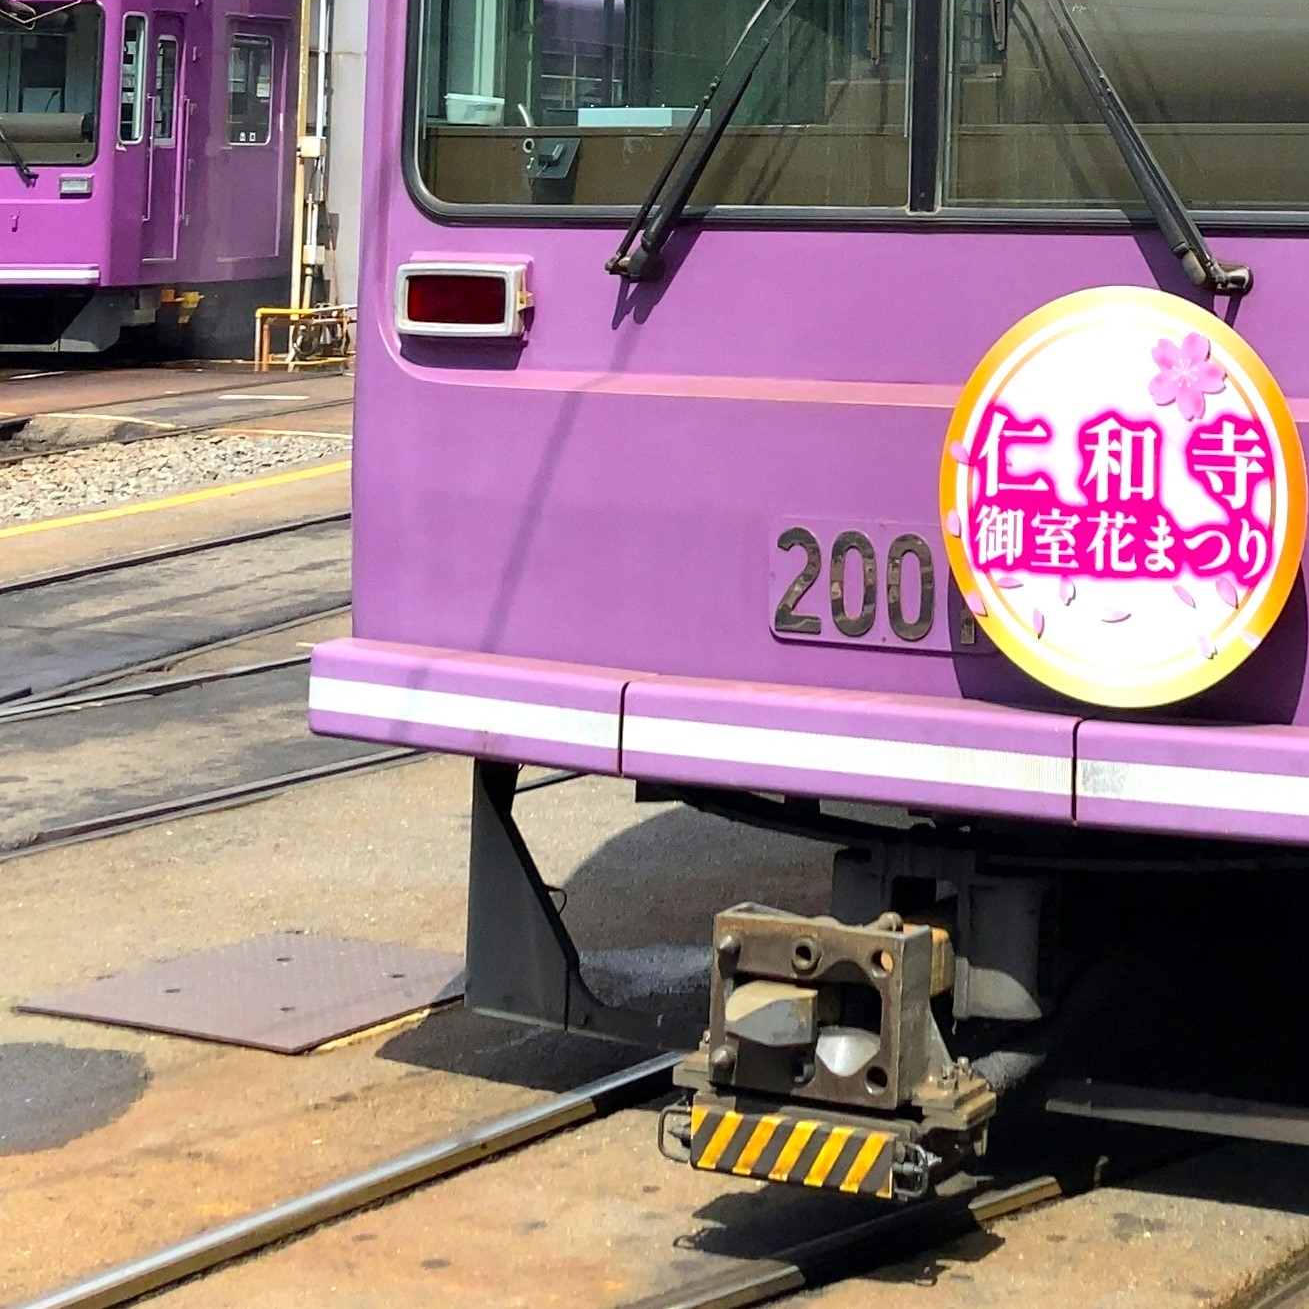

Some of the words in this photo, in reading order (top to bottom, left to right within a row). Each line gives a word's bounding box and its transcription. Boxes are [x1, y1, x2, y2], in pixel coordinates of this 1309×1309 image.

[978, 413, 1266, 510] 仁和寺
[774, 526, 976, 644] 200
[974, 505, 1269, 580] 御室花まつり
